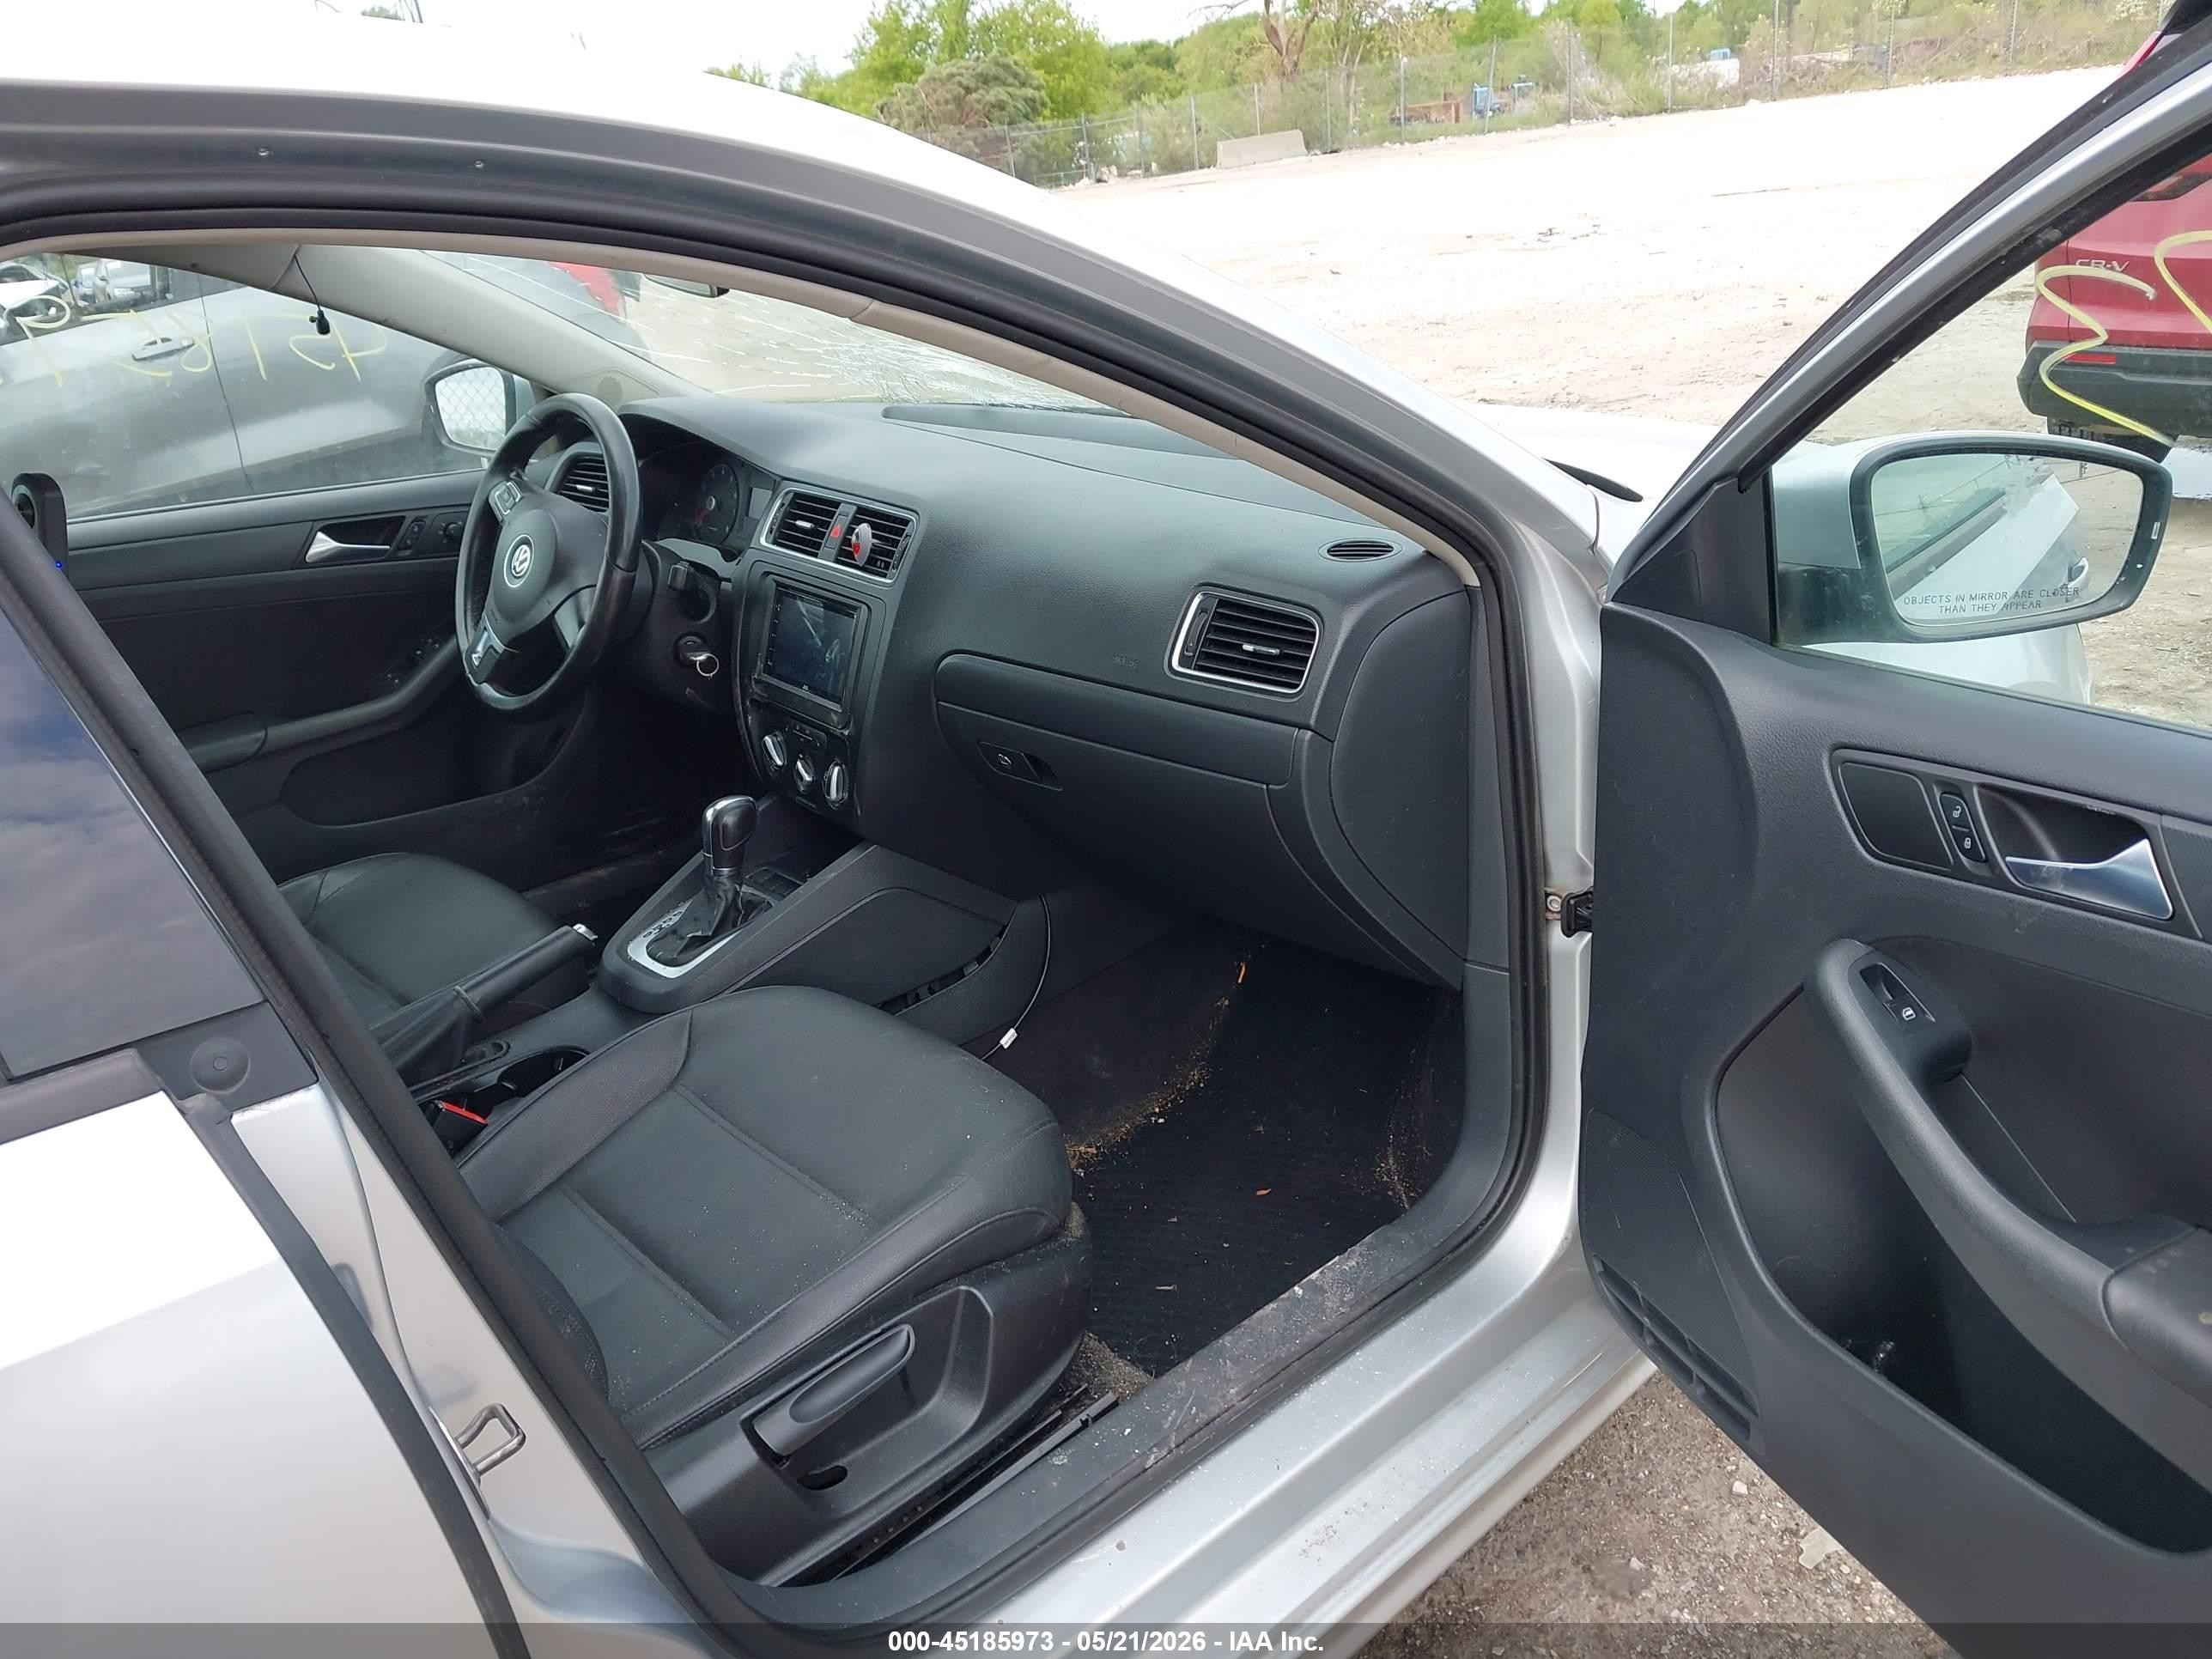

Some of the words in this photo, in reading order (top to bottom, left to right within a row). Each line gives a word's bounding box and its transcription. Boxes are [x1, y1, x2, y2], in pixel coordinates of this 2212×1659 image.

[2075, 258, 2130, 272] CR-V
[1904, 594, 1951, 605] OBJECTS
[1955, 594, 1966, 603] IN
[1969, 592, 2008, 602] MIRROR
[2014, 590, 2033, 599] ARE
[2039, 587, 2080, 599] CLOSER
[1939, 605, 1966, 614] THAN
[1972, 603, 1997, 612] THEY
[2001, 600, 2042, 611] APPEAR
